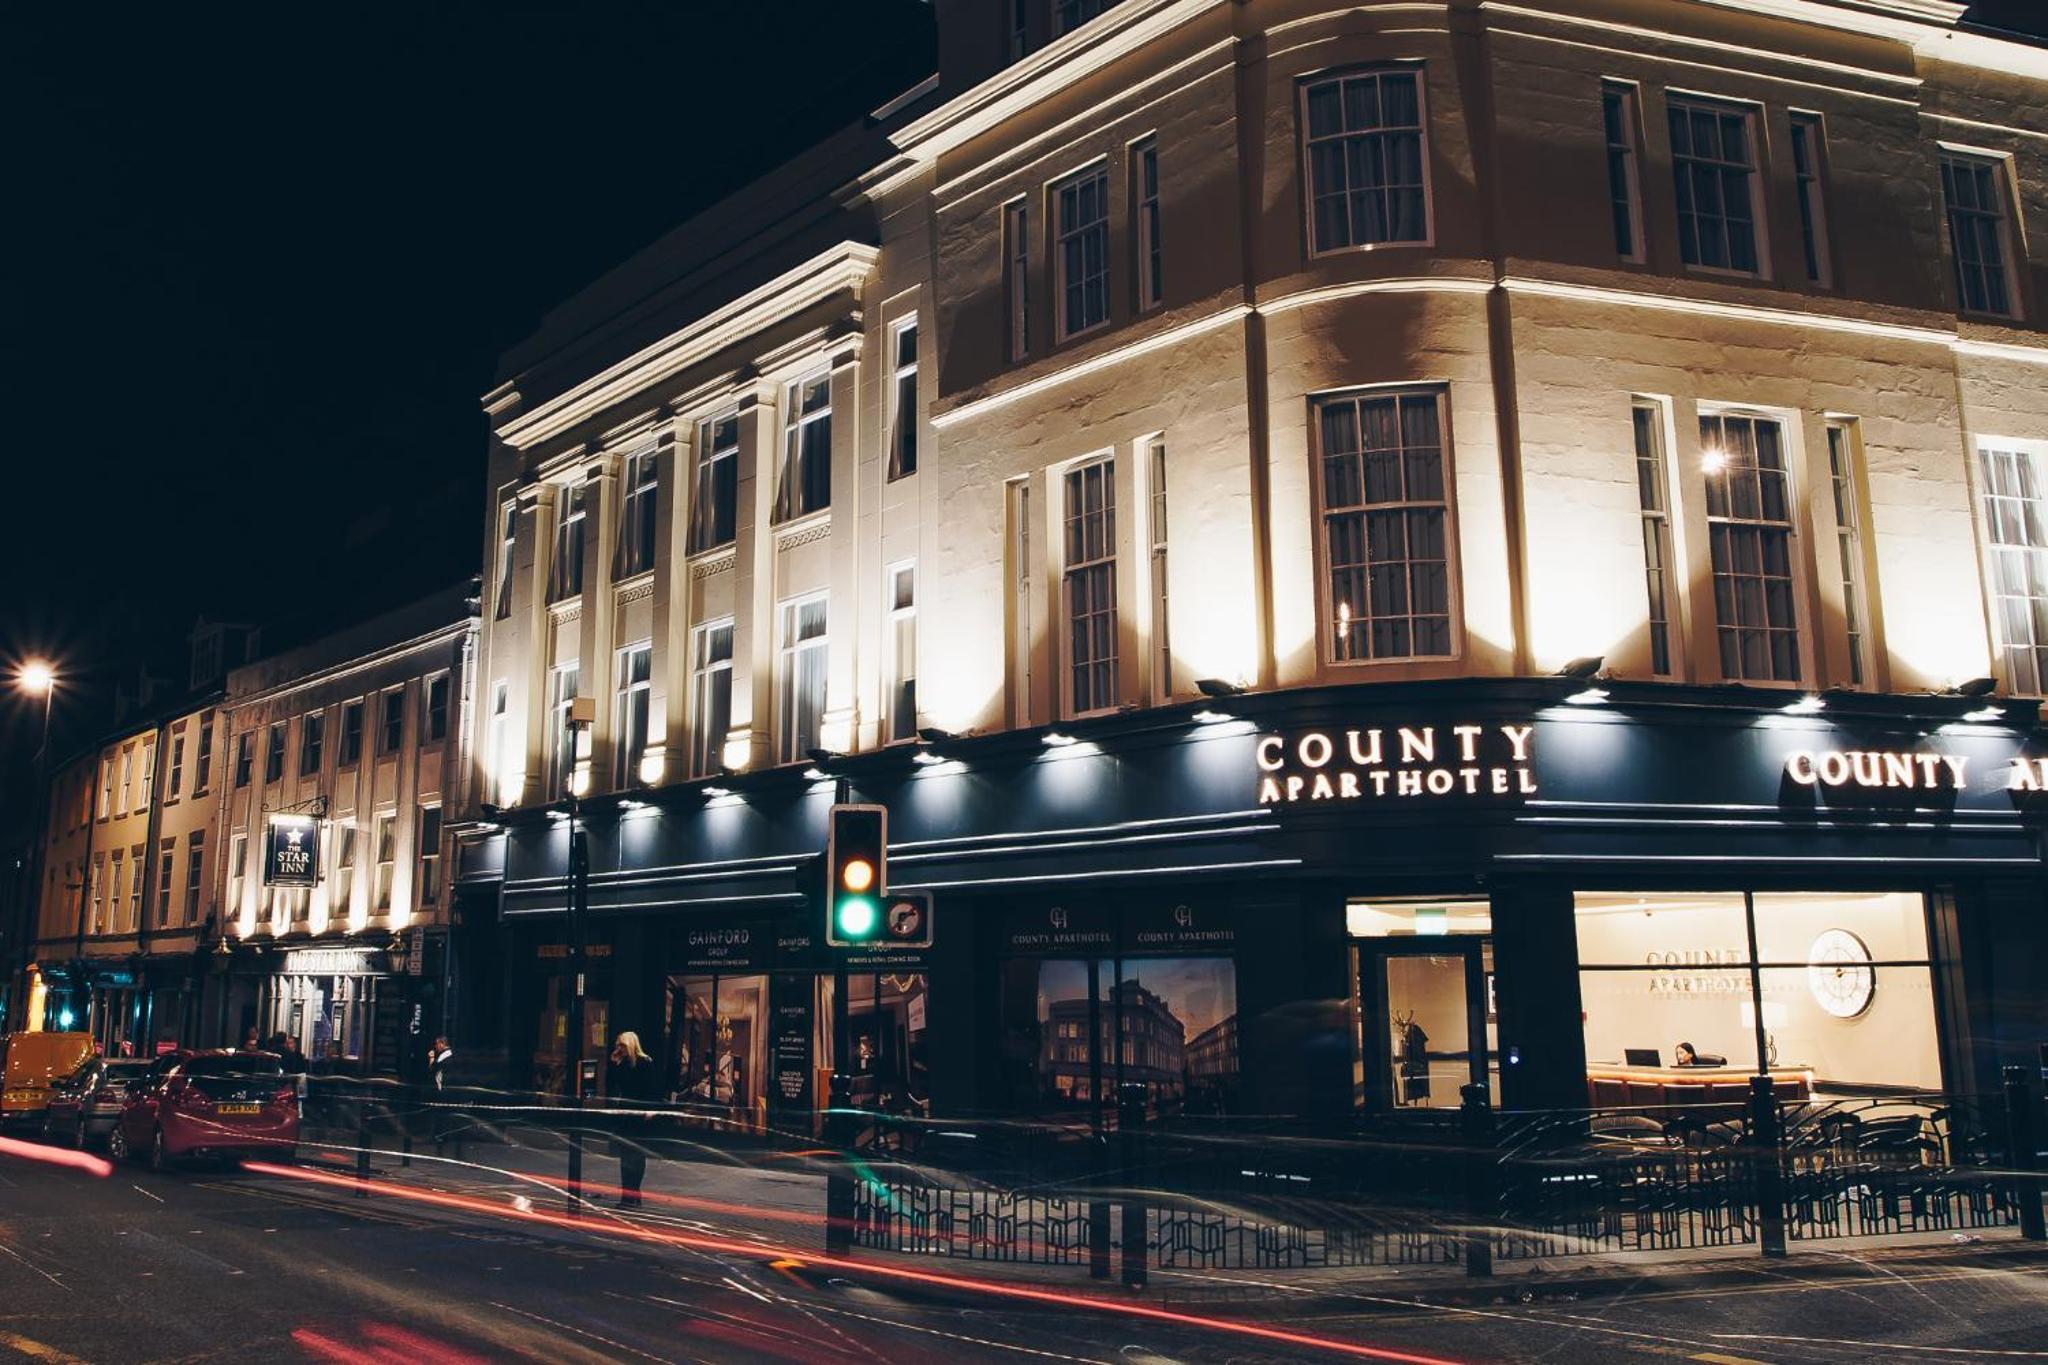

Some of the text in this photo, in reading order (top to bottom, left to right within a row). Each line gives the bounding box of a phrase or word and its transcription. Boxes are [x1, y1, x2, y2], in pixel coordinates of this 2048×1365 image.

[1256, 724, 1534, 771] COUNTY
[1787, 751, 1968, 789] COUNTY
[1259, 767, 1538, 804] APARTHOTEL
[277, 851, 310, 863] STAR
[280, 862, 306, 873] INN
[688, 929, 750, 946] GAINFORD
[1012, 931, 1112, 945] COUNTY APARTHOTEL
[1136, 930, 1235, 943] COUNTY APARTHOTEL
